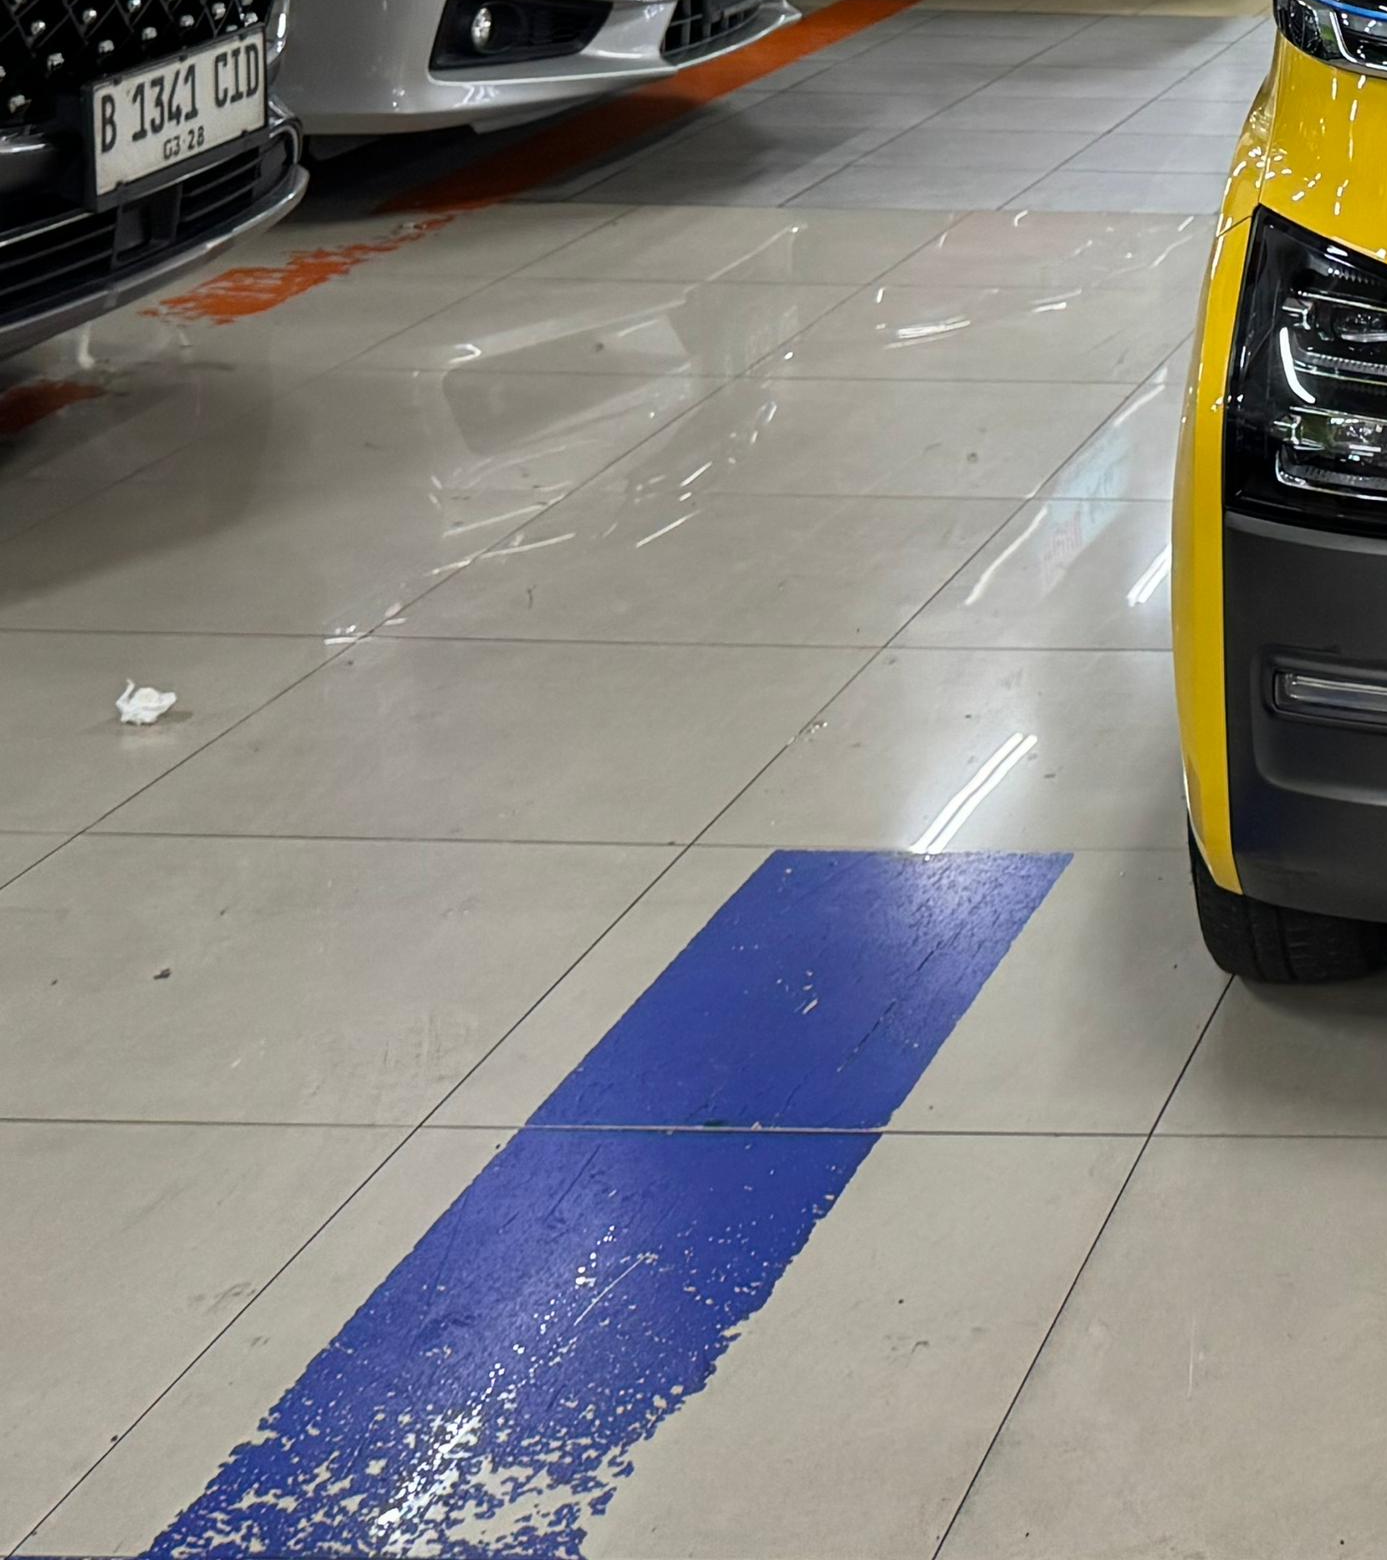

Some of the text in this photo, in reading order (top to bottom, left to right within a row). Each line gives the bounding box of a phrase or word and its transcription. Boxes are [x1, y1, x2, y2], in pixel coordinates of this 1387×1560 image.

[101, 43, 260, 154] B 1341 CID
